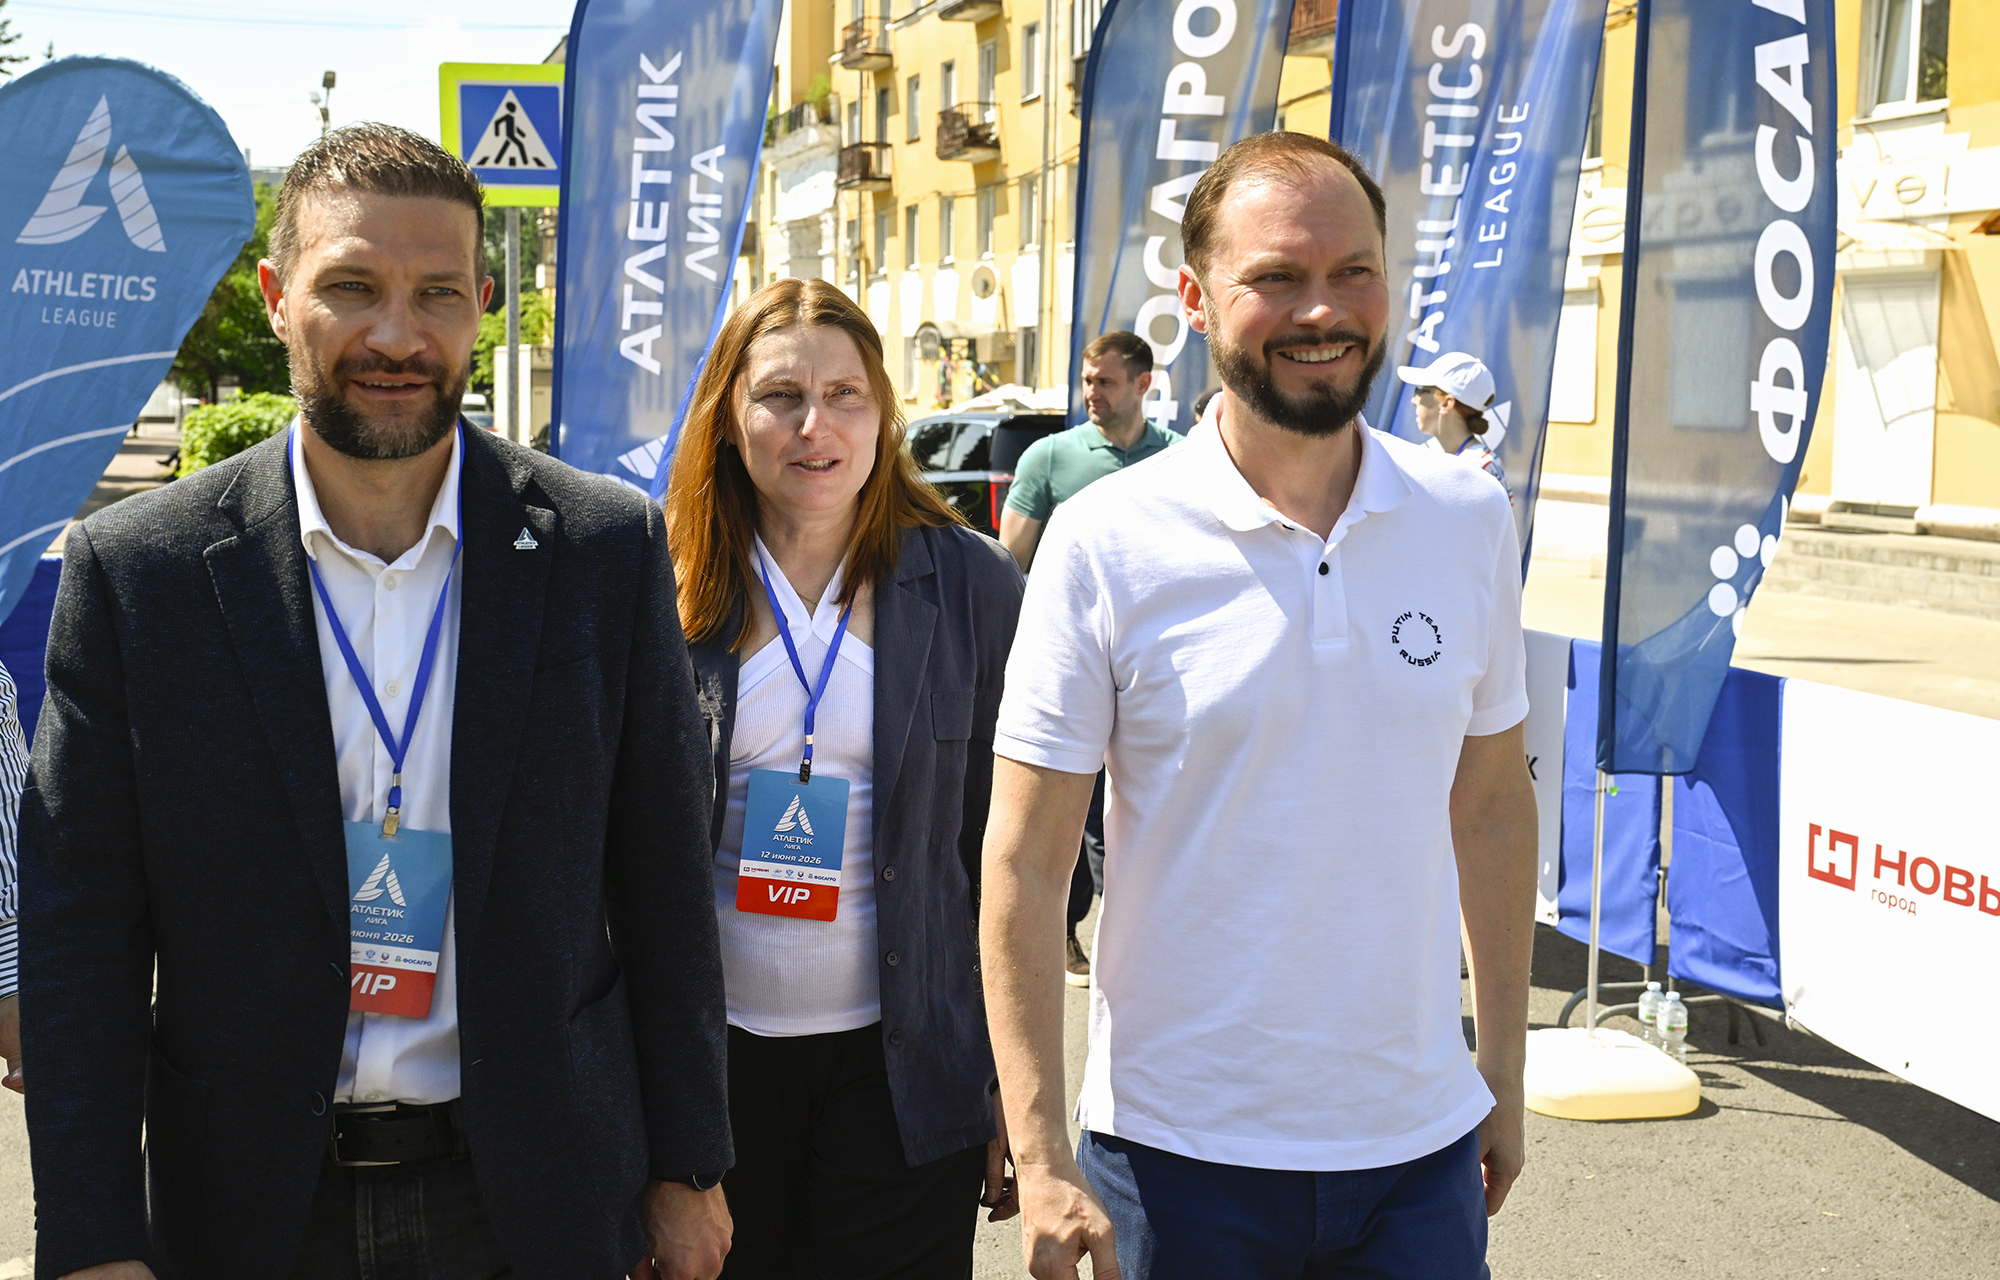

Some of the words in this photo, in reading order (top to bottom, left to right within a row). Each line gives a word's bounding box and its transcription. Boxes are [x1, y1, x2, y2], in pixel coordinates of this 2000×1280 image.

[1406, 22, 1487, 354] ATHLETICS
[1472, 101, 1530, 269] LEAGUE
[619, 50, 682, 376] АТЛЕТИК
[684, 143, 726, 282] ЛИГА
[11, 267, 157, 302] ATHLETICS
[41, 307, 117, 329] LEAGUE
[1391, 611, 1413, 644] PUTIN
[1418, 611, 1443, 644] TEAM
[1399, 648, 1442, 667] RUSSIA
[772, 833, 813, 845] АТЛЕТИК
[760, 850, 770, 858] 12
[797, 855, 821, 864] 2026
[768, 884, 810, 904] VIP
[1871, 888, 1918, 917] город
[350, 904, 404, 919] АТЛЕТИК
[364, 916, 387, 925] ЛИГА
[382, 931, 414, 943] 2026
[402, 957, 432, 966] ФОСАГРО
